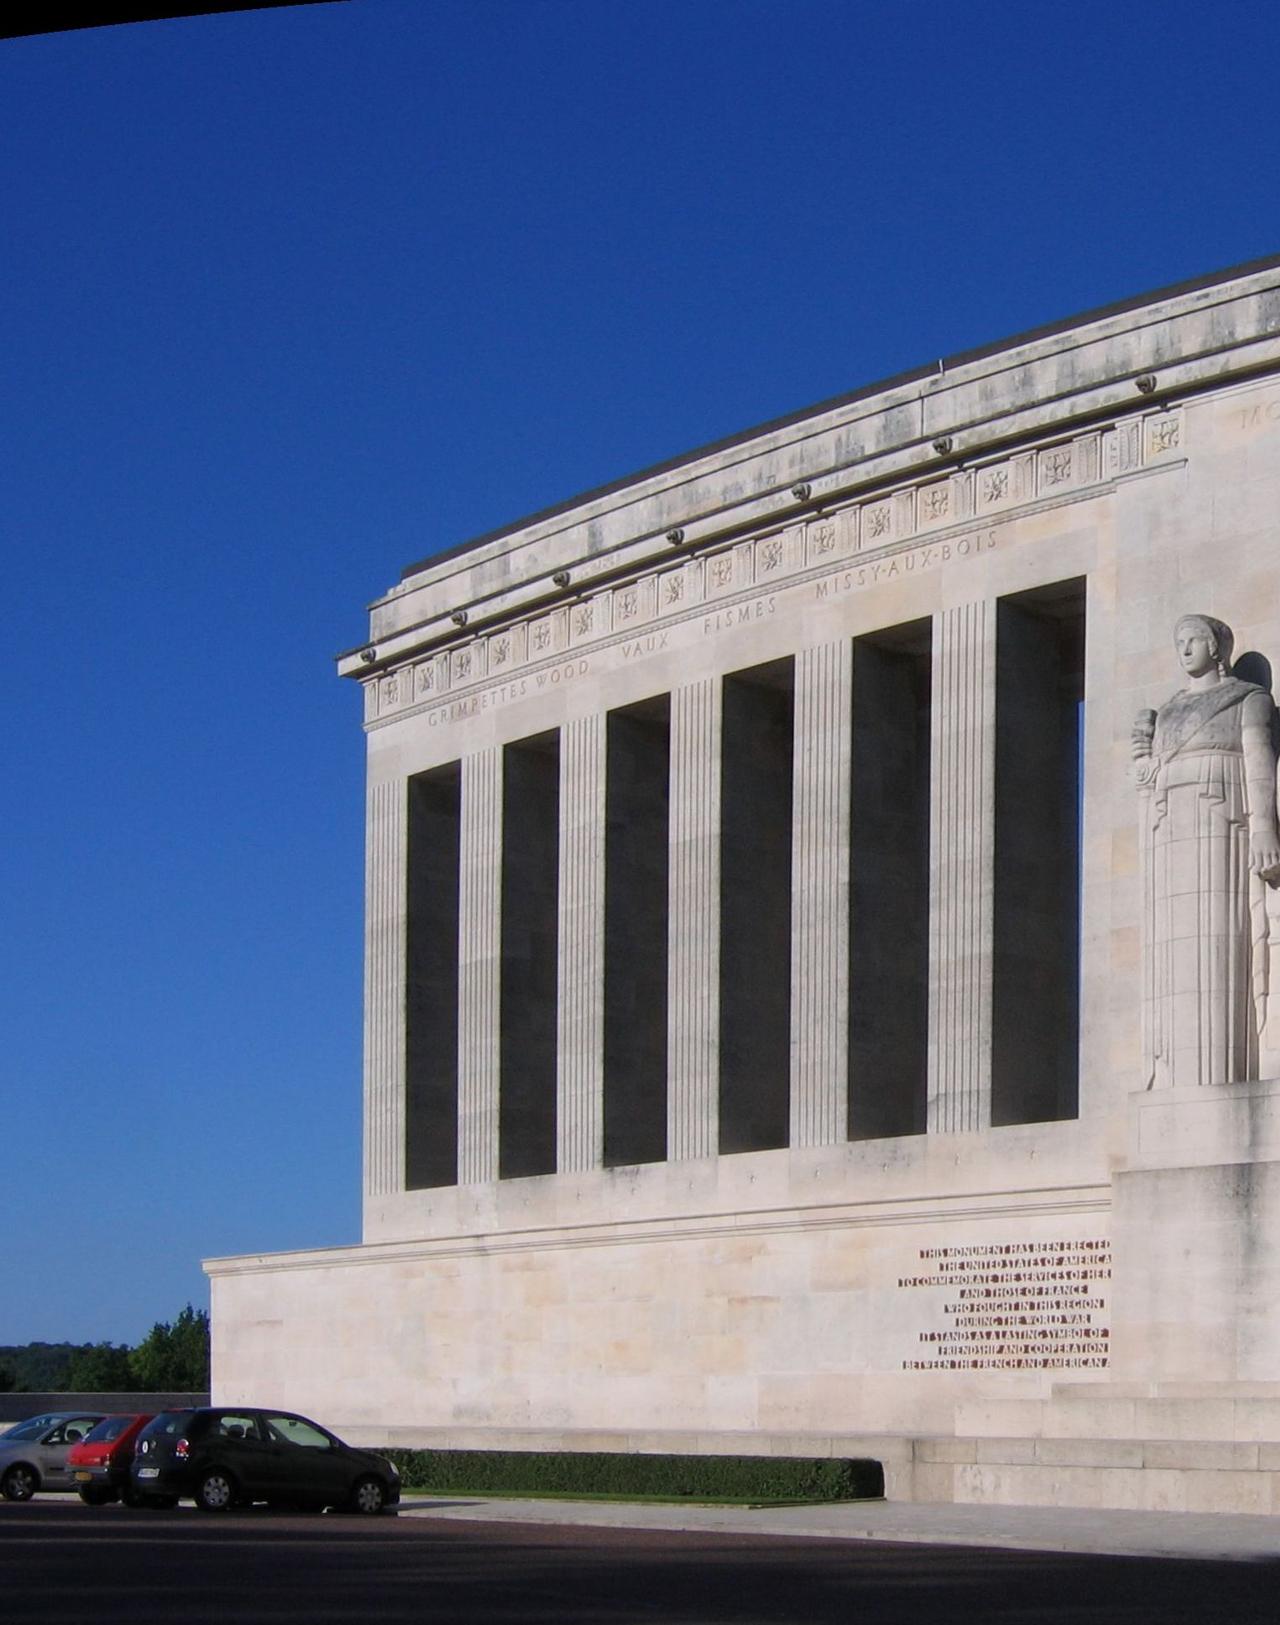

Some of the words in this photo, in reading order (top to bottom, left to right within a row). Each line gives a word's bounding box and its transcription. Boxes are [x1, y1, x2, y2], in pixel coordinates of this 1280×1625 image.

[814, 530, 998, 599] MISSY-AUX-BOIS
[703, 597, 776, 634] FISMES
[621, 632, 670, 658] VAUX
[428, 681, 527, 726] GRIMPETTES
[536, 661, 590, 688] WOOD
[923, 1248, 943, 1258] THIS
[948, 1245, 1005, 1257] MONUMENT
[1010, 1243, 1030, 1253] HAS
[1034, 1241, 1060, 1252] BEEN
[1064, 1239, 1110, 1250] ERECTED
[943, 1262, 960, 1271] THE
[966, 1259, 1001, 1270] UNITED
[1006, 1257, 1041, 1268] STATES
[1062, 1254, 1111, 1265] AMERICA
[917, 1275, 994, 1286] COMMEMORATE
[998, 1273, 1014, 1283] THE
[1018, 1271, 1065, 1282] SERVICES
[965, 1289, 986, 1298] AND
[991, 1287, 1023, 1297] THOSE
[1042, 1285, 1086, 1296] FRANCE
[947, 1303, 970, 1313] WHO
[975, 1301, 1014, 1312] FOUGHT
[1034, 1300, 1056, 1310] THIS
[1060, 1298, 1100, 1309] REGION
[958, 1316, 997, 1326] DURING
[1002, 1315, 1020, 1325] THE
[1024, 1314, 1061, 1325] WORLD
[1064, 1313, 1087, 1324] WAR
[934, 1331, 971, 1341] STANDS
[1000, 1329, 1042, 1340] LASTING
[1046, 1328, 1084, 1339] SYMBOL
[942, 1345, 998, 1355] FRIENDSHIP
[1002, 1344, 1023, 1354] AND
[1030, 1342, 1104, 1353] COOPERATION
[905, 1359, 951, 1369] BETWEEN
[955, 1359, 973, 1369] THE
[977, 1358, 1016, 1369] FRENCH
[1020, 1358, 1042, 1368] AND
[1046, 1357, 1102, 1368] AMERICAN
